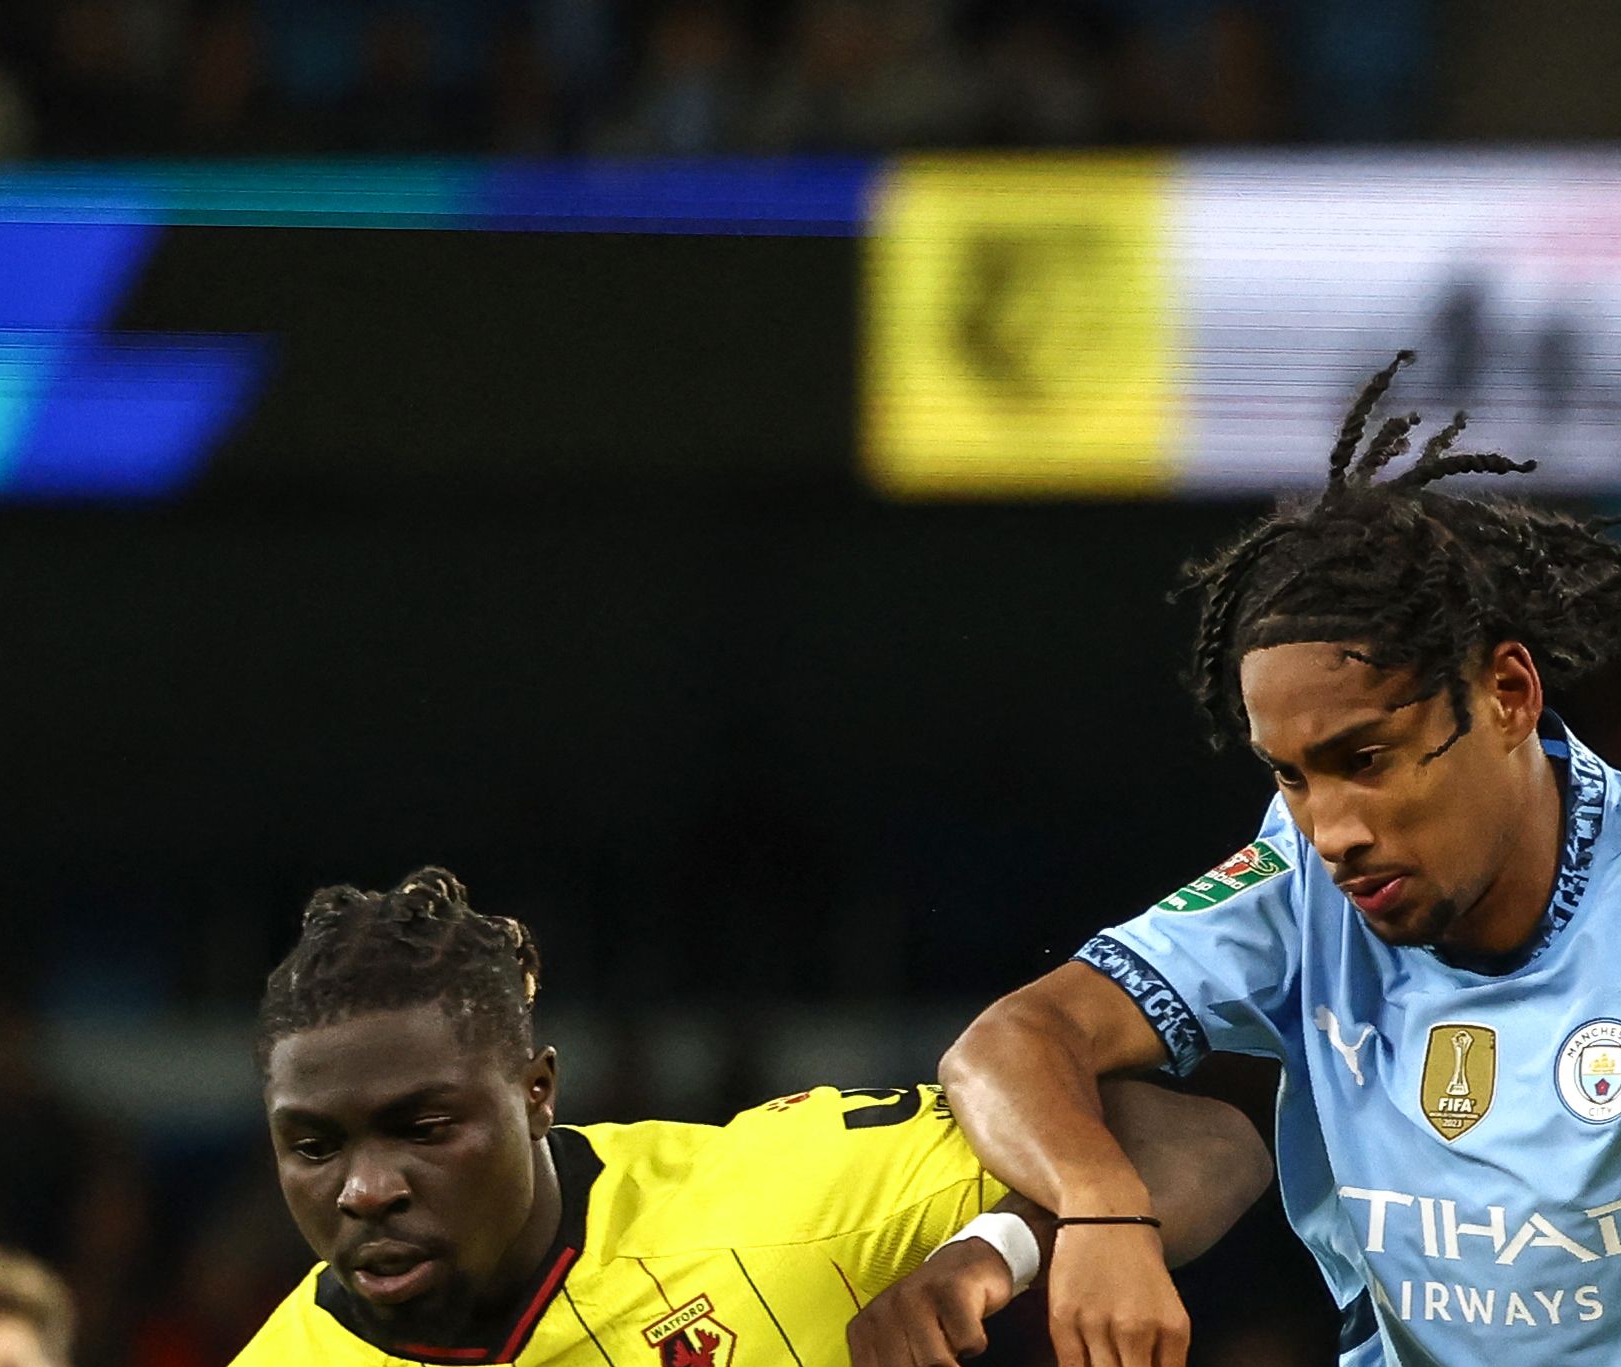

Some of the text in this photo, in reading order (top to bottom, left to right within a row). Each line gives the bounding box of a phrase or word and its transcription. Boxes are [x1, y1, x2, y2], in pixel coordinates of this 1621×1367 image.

[1438, 1097, 1473, 1113] FIFA
[1588, 1106, 1613, 1117] CITY
[1396, 1278, 1605, 1327] IRWAYS
[650, 1302, 706, 1340] WATFORD
